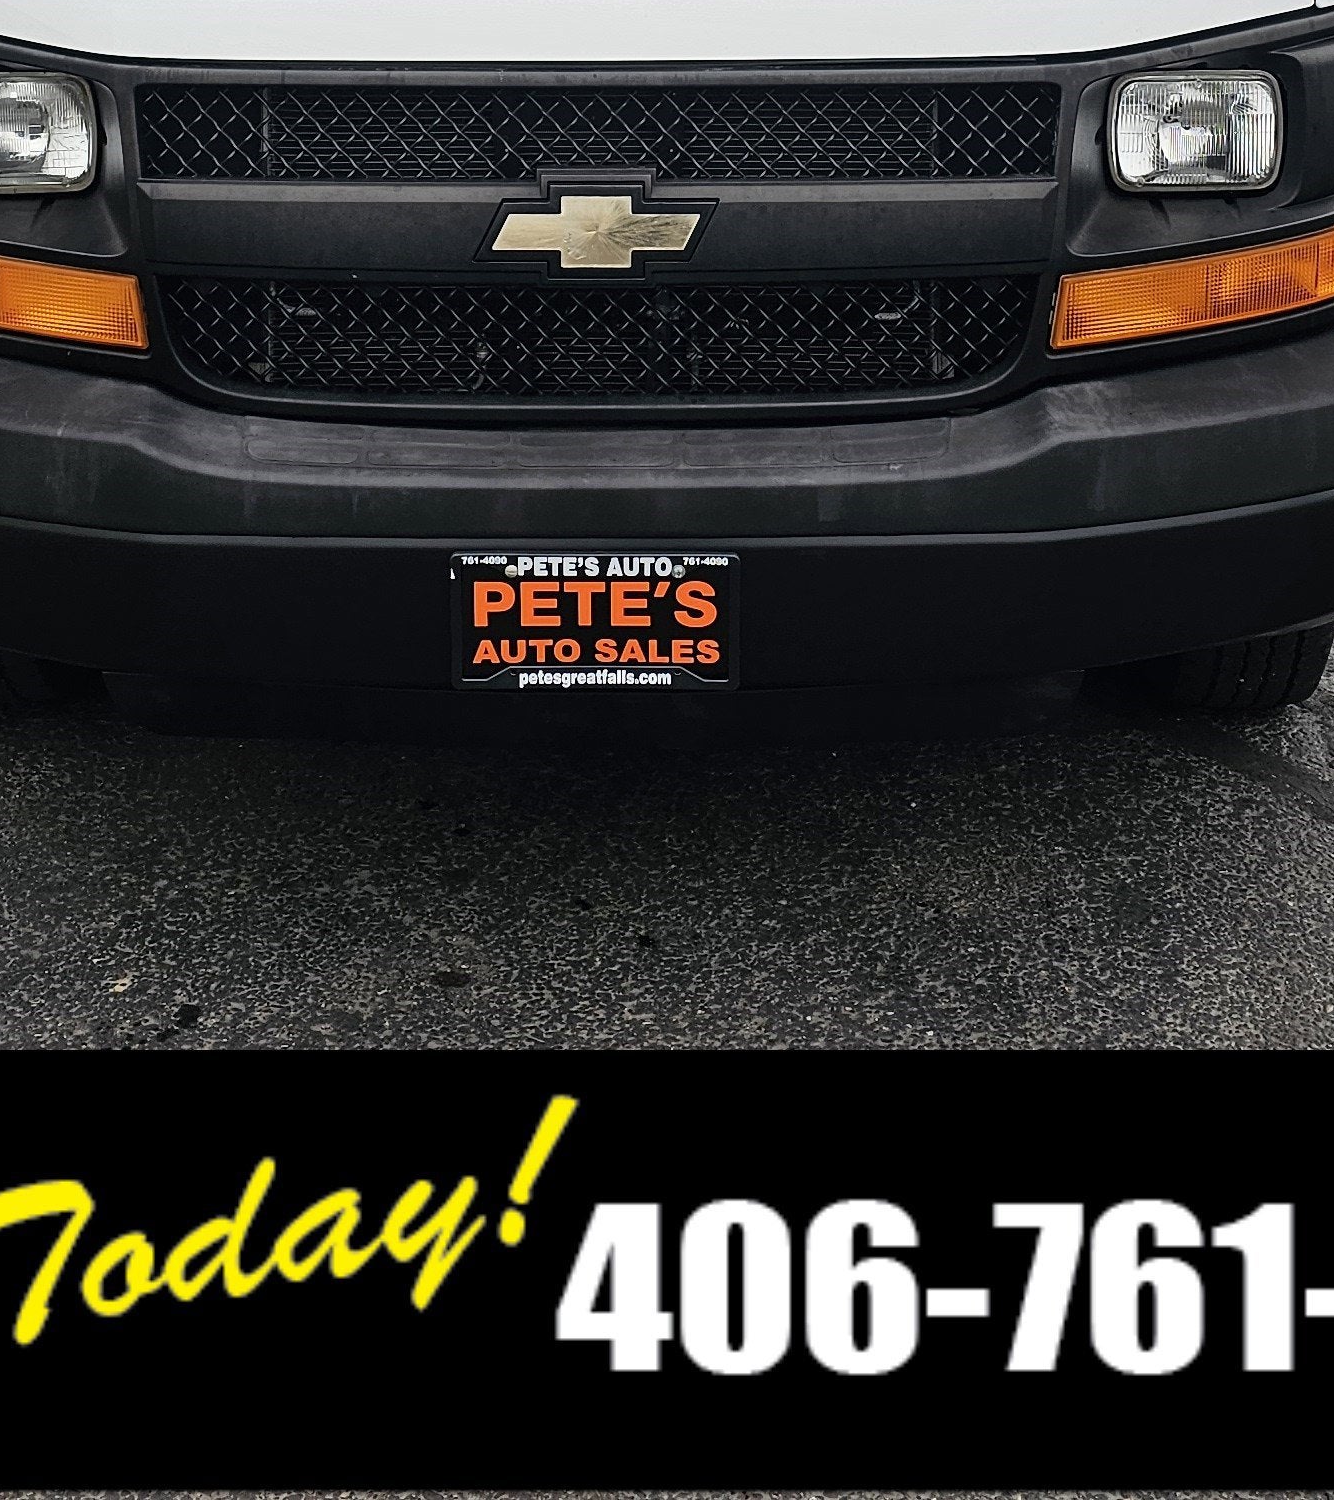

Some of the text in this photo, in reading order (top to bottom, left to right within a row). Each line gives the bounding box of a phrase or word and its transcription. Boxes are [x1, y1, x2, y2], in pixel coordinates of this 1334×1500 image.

[461, 556, 508, 565] 761-4090
[517, 556, 673, 577] PETE'S AUTO
[682, 556, 729, 566] 761-4090
[473, 580, 718, 628] PETE'S
[472, 638, 720, 664] AUTO SALES
[519, 669, 672, 688] petesgreatfalls.com
